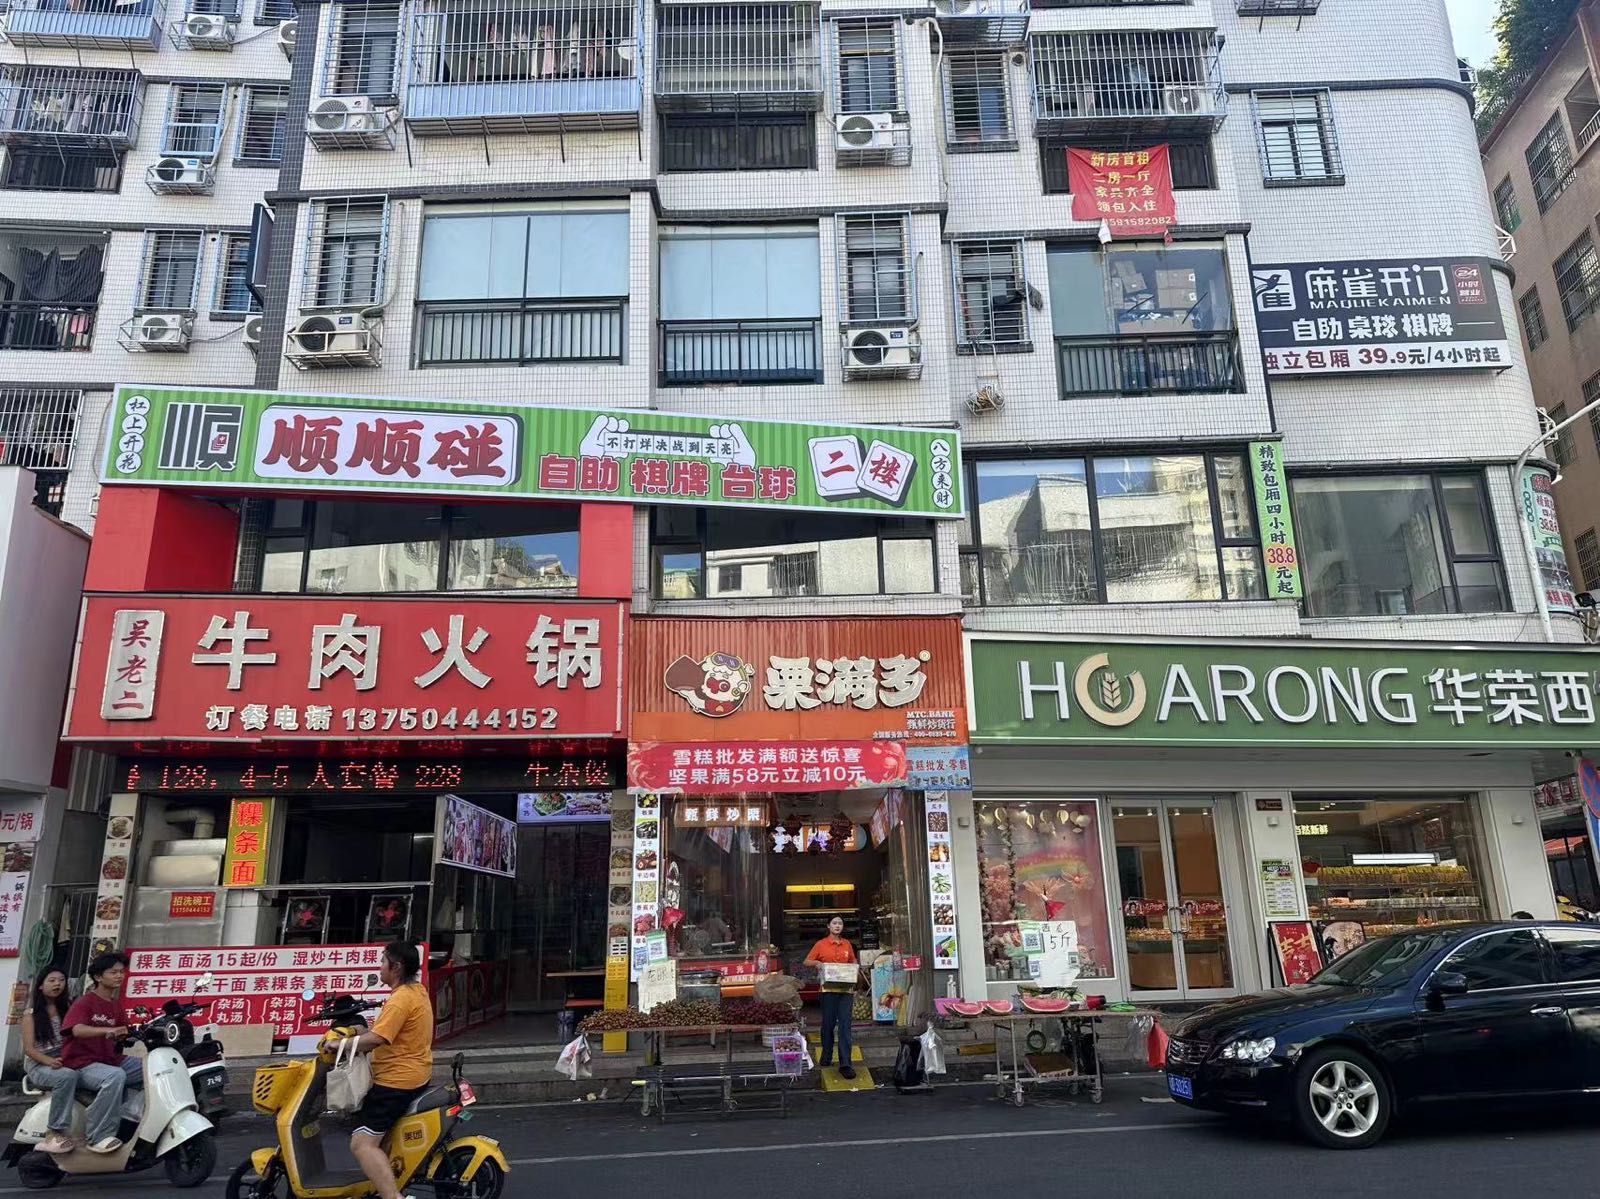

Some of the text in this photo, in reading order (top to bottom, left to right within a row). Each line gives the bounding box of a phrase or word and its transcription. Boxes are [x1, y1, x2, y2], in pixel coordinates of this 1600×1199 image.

[1304, 264, 1449, 298] 麻雀开门
[1310, 297, 1451, 310] MAQUEKAIMEN
[1293, 313, 1453, 341] 自助 桌球 棋牌
[1264, 345, 1501, 371] 独立包厢 39.9元/4小时起
[119, 397, 147, 471] 杠上开花
[262, 414, 506, 480] 顺顺碰
[605, 435, 734, 457] 不打烊决战到天亮
[538, 448, 902, 500] 自助 棋牌 台球 二楼
[930, 439, 951, 506] 八方来财
[111, 609, 602, 712] 吴老二 牛肉火锅
[763, 653, 928, 709] 栗满多
[1427, 667, 1600, 724] 华荣西
[205, 704, 558, 731] 订餐电话 13750444152
[672, 747, 861, 767] 雪糕批发满额送惊喜
[668, 765, 868, 785] 坚果满58元立减10元
[0, 812, 34, 832] 元/锅
[231, 801, 264, 884] 粿条面
[172, 895, 212, 906] 招洗碗工
[136, 949, 384, 969] 粿条 面汤 15起/份 湿炒牛肉粿
[132, 979, 186, 994] 素干粿
[253, 976, 305, 991] 素粿条
[312, 974, 364, 989] 素面汤
[404, 1129, 423, 1142] 美团
